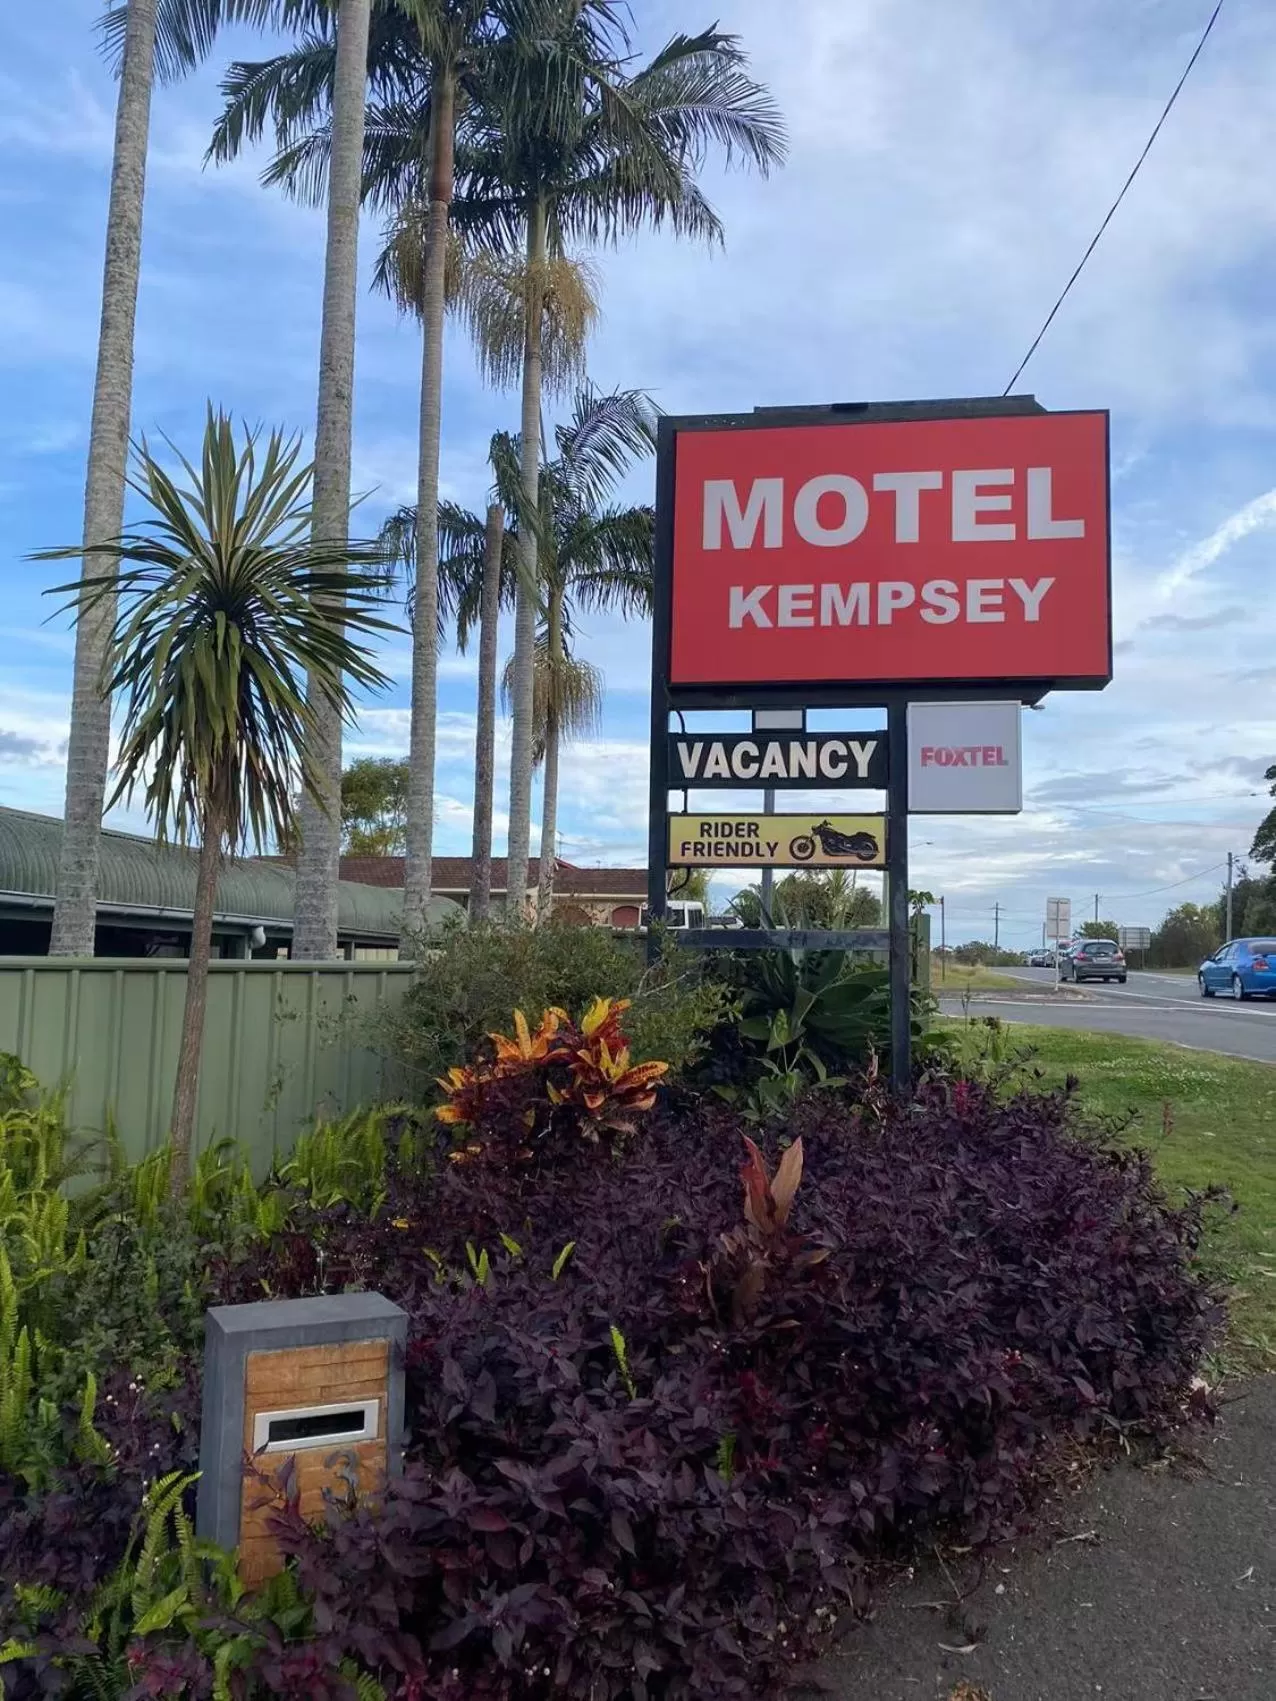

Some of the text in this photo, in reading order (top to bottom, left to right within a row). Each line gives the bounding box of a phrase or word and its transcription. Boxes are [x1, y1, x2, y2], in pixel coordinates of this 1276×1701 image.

[703, 467, 1085, 550] MOTEL
[729, 577, 1055, 628] KEMPSEY
[677, 740, 877, 778] VACANCY
[920, 746, 1009, 767] FOXTEL
[699, 822, 760, 838] RIDER
[681, 841, 779, 857] FRIENDLY
